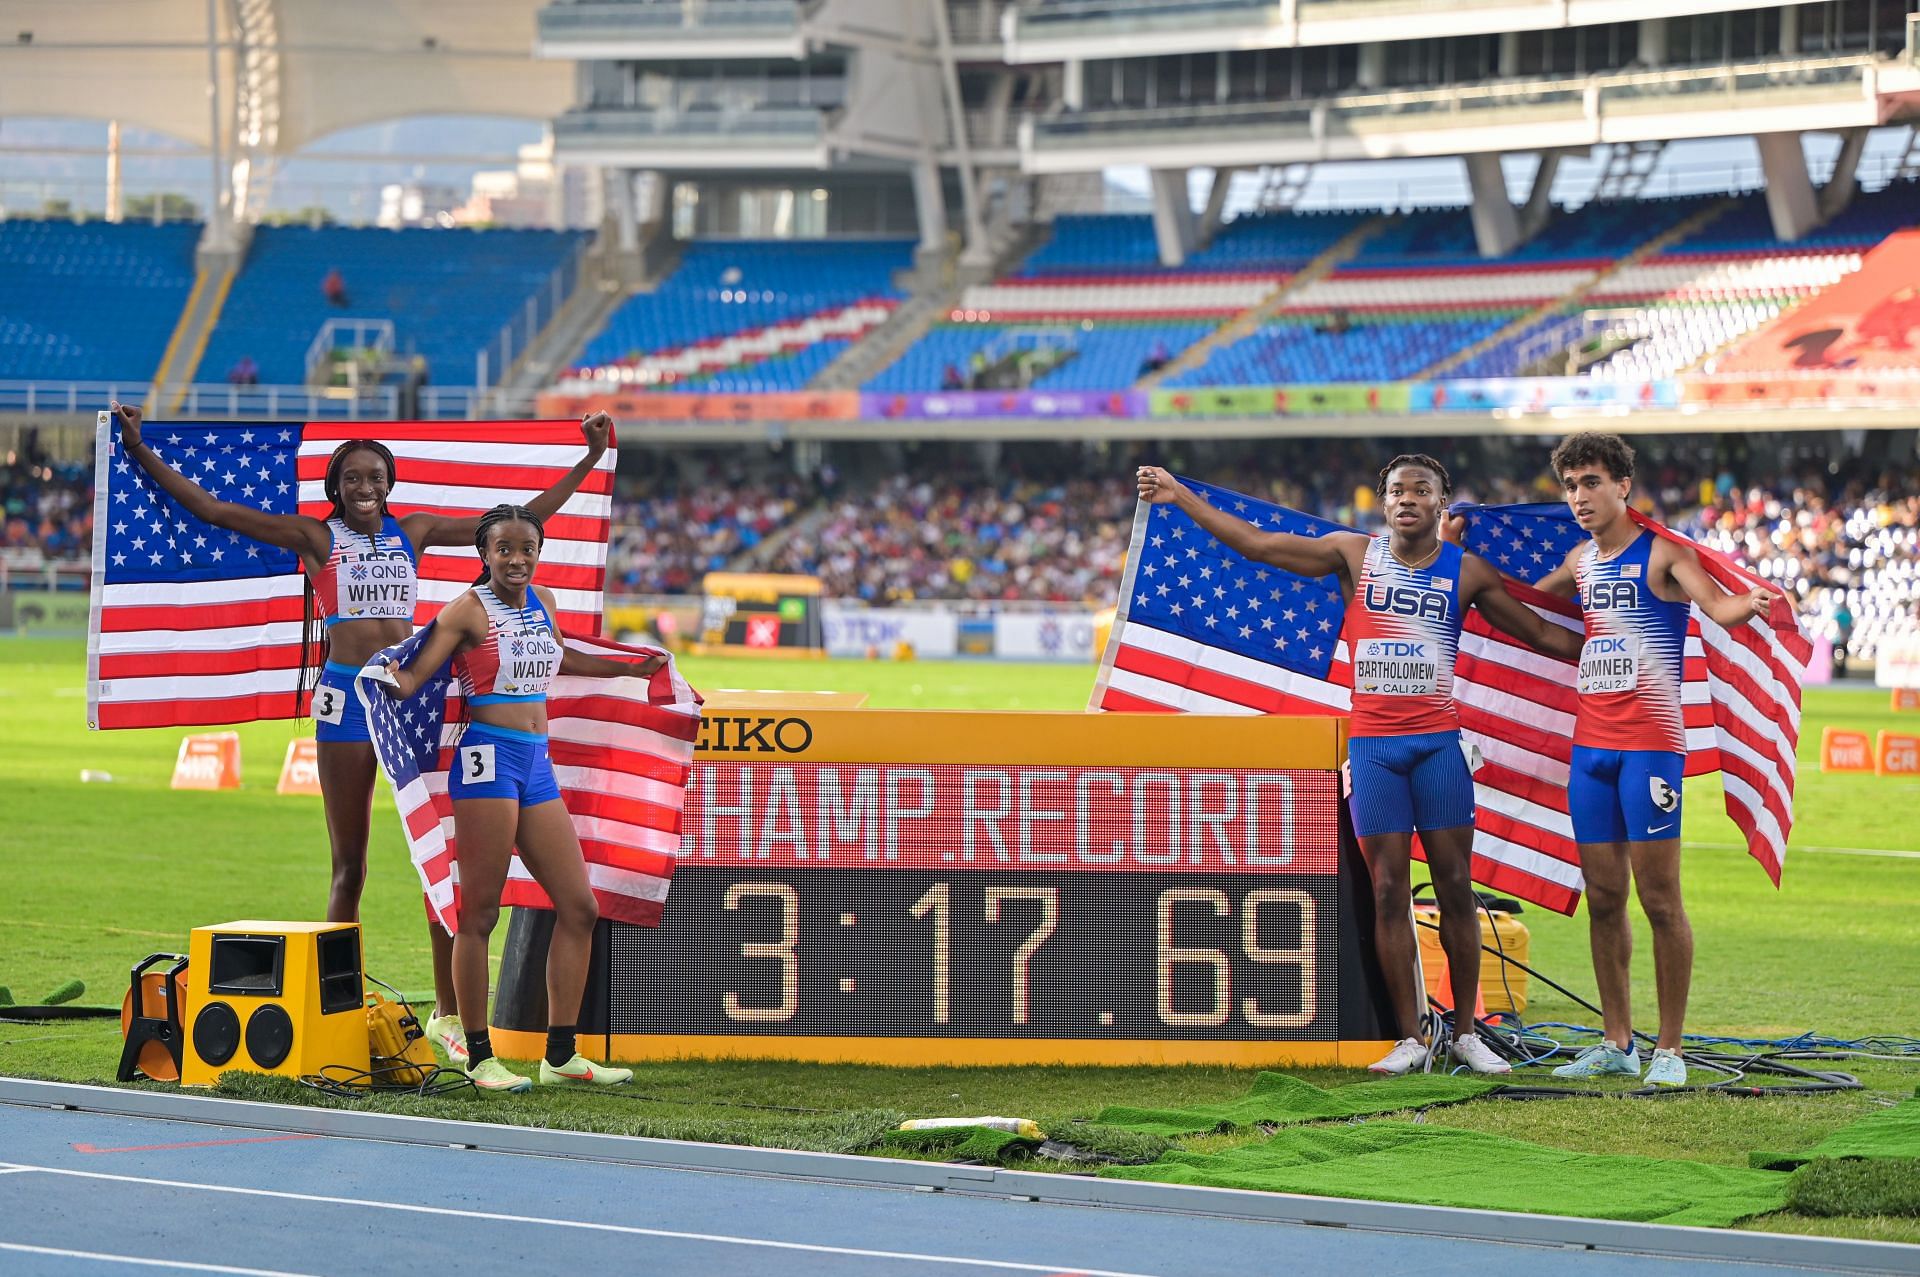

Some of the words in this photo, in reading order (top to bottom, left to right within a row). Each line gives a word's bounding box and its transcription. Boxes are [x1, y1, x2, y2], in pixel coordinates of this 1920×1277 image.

[371, 565, 408, 579] QNB
[347, 584, 410, 602] WHYTE
[1364, 583, 1450, 622] USA
[1580, 580, 1637, 612] USA
[369, 606, 395, 616] CALI
[396, 606, 408, 616] 22
[526, 641, 556, 655] QNB
[1381, 642, 1425, 658] TDK
[1591, 637, 1627, 654] TDK
[513, 660, 553, 679] WADE
[1358, 660, 1435, 680] BARTHOLOMEW
[1579, 658, 1633, 679] SUMNER
[523, 683, 541, 693] CALI
[1382, 683, 1409, 694] CALI
[1411, 684, 1427, 694] 22
[1591, 681, 1613, 691] CALI
[1614, 679, 1628, 689] 22
[319, 692, 335, 717] 3
[469, 751, 485, 778] 3
[1659, 783, 1674, 809] 3
[676, 765, 1296, 866] HAMP.RECORD
[722, 881, 1317, 1028] 3:17.69
